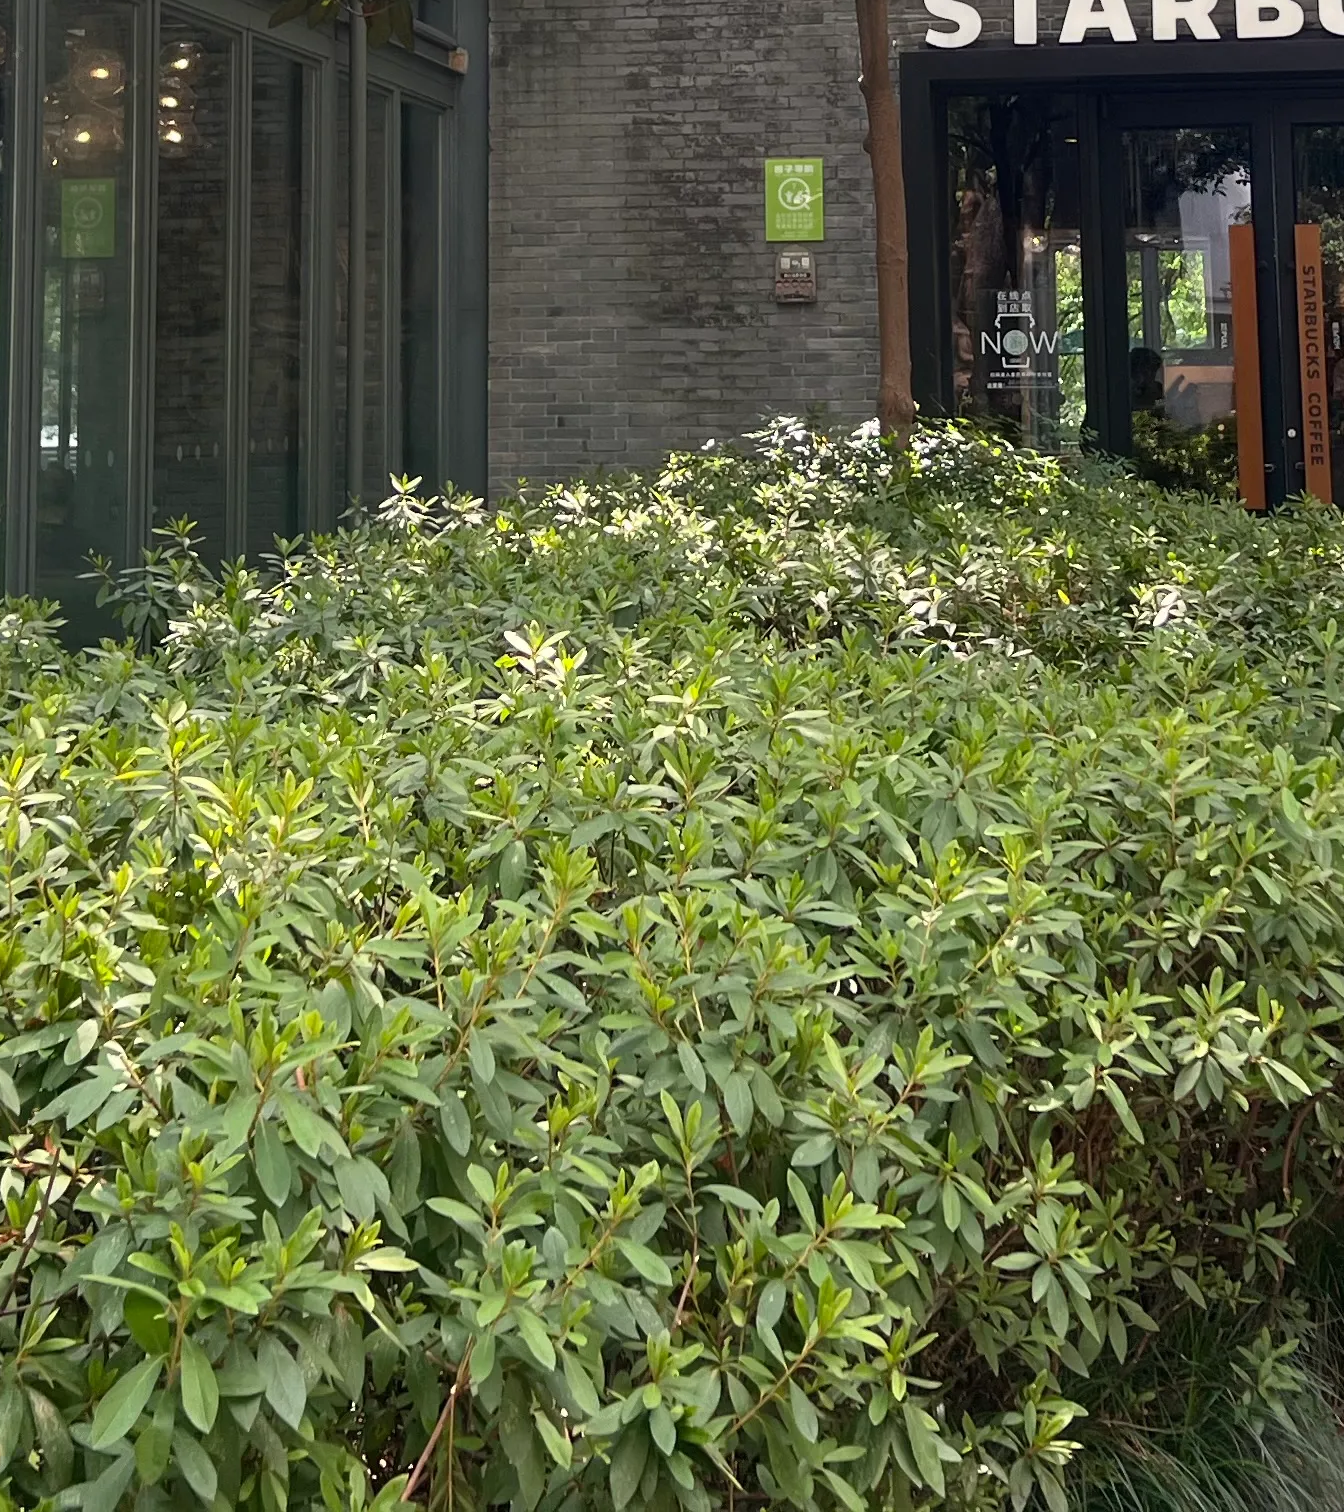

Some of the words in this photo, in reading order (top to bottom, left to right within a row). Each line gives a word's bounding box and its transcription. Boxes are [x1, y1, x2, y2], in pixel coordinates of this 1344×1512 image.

[981, 330, 1059, 356] NOW
[1302, 264, 1320, 380] STARBUCKS
[1308, 392, 1324, 466] COFFEE
